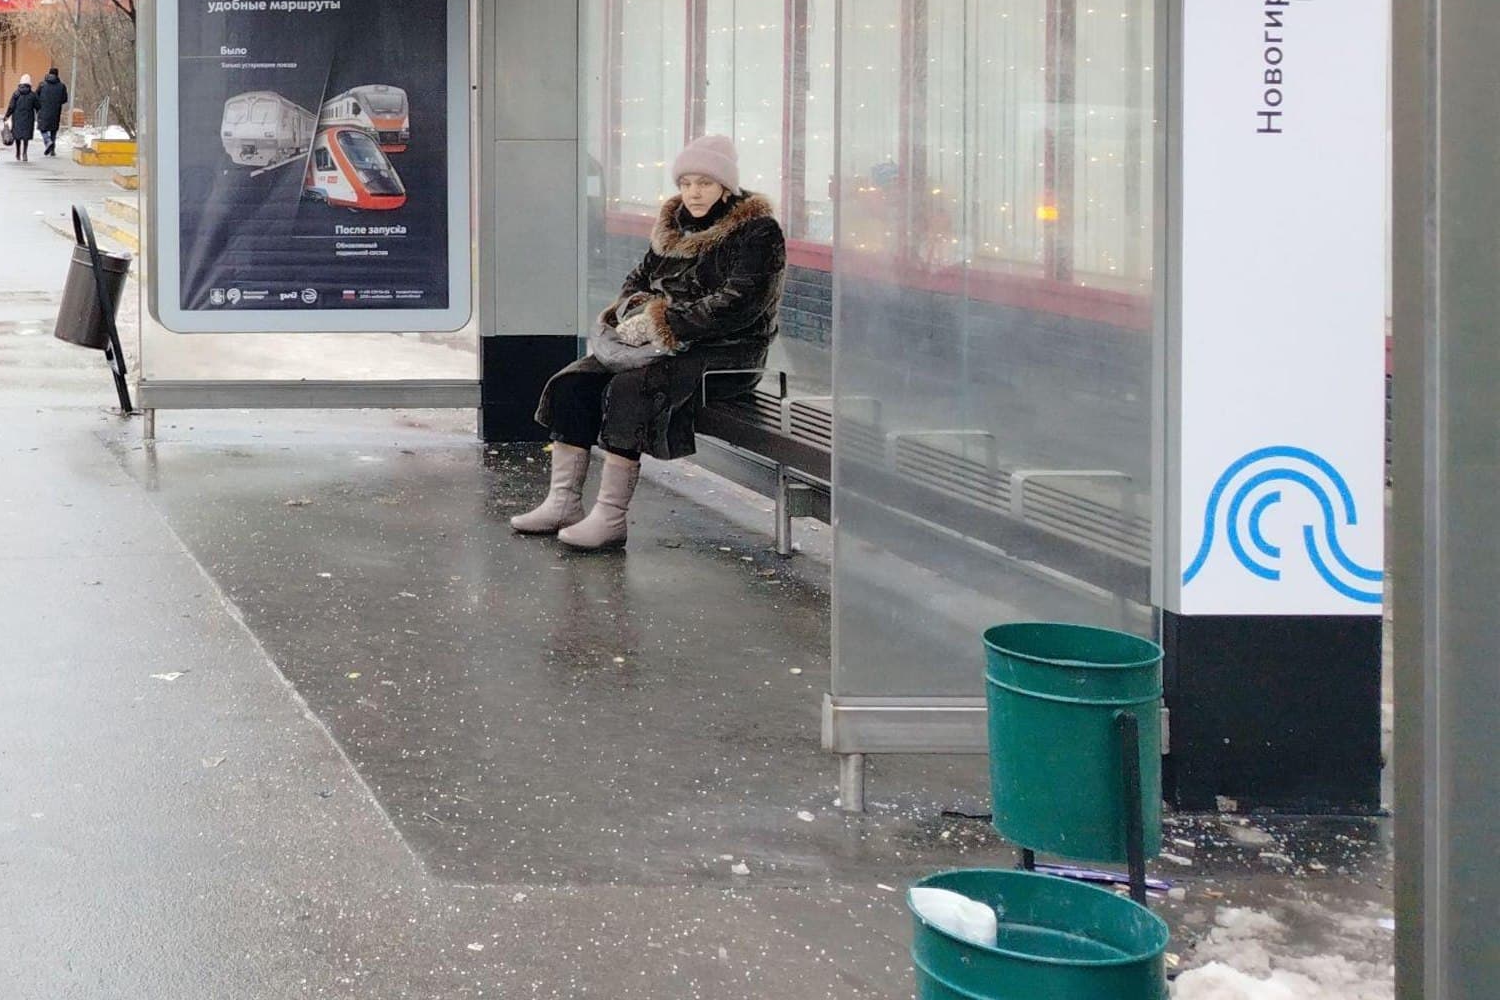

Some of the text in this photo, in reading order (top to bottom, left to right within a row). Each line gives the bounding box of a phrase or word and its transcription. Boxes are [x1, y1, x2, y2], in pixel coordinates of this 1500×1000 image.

[207, 0, 341, 13] удобные маршруты
[220, 46, 247, 55] Было
[335, 225, 407, 237] После запуска
